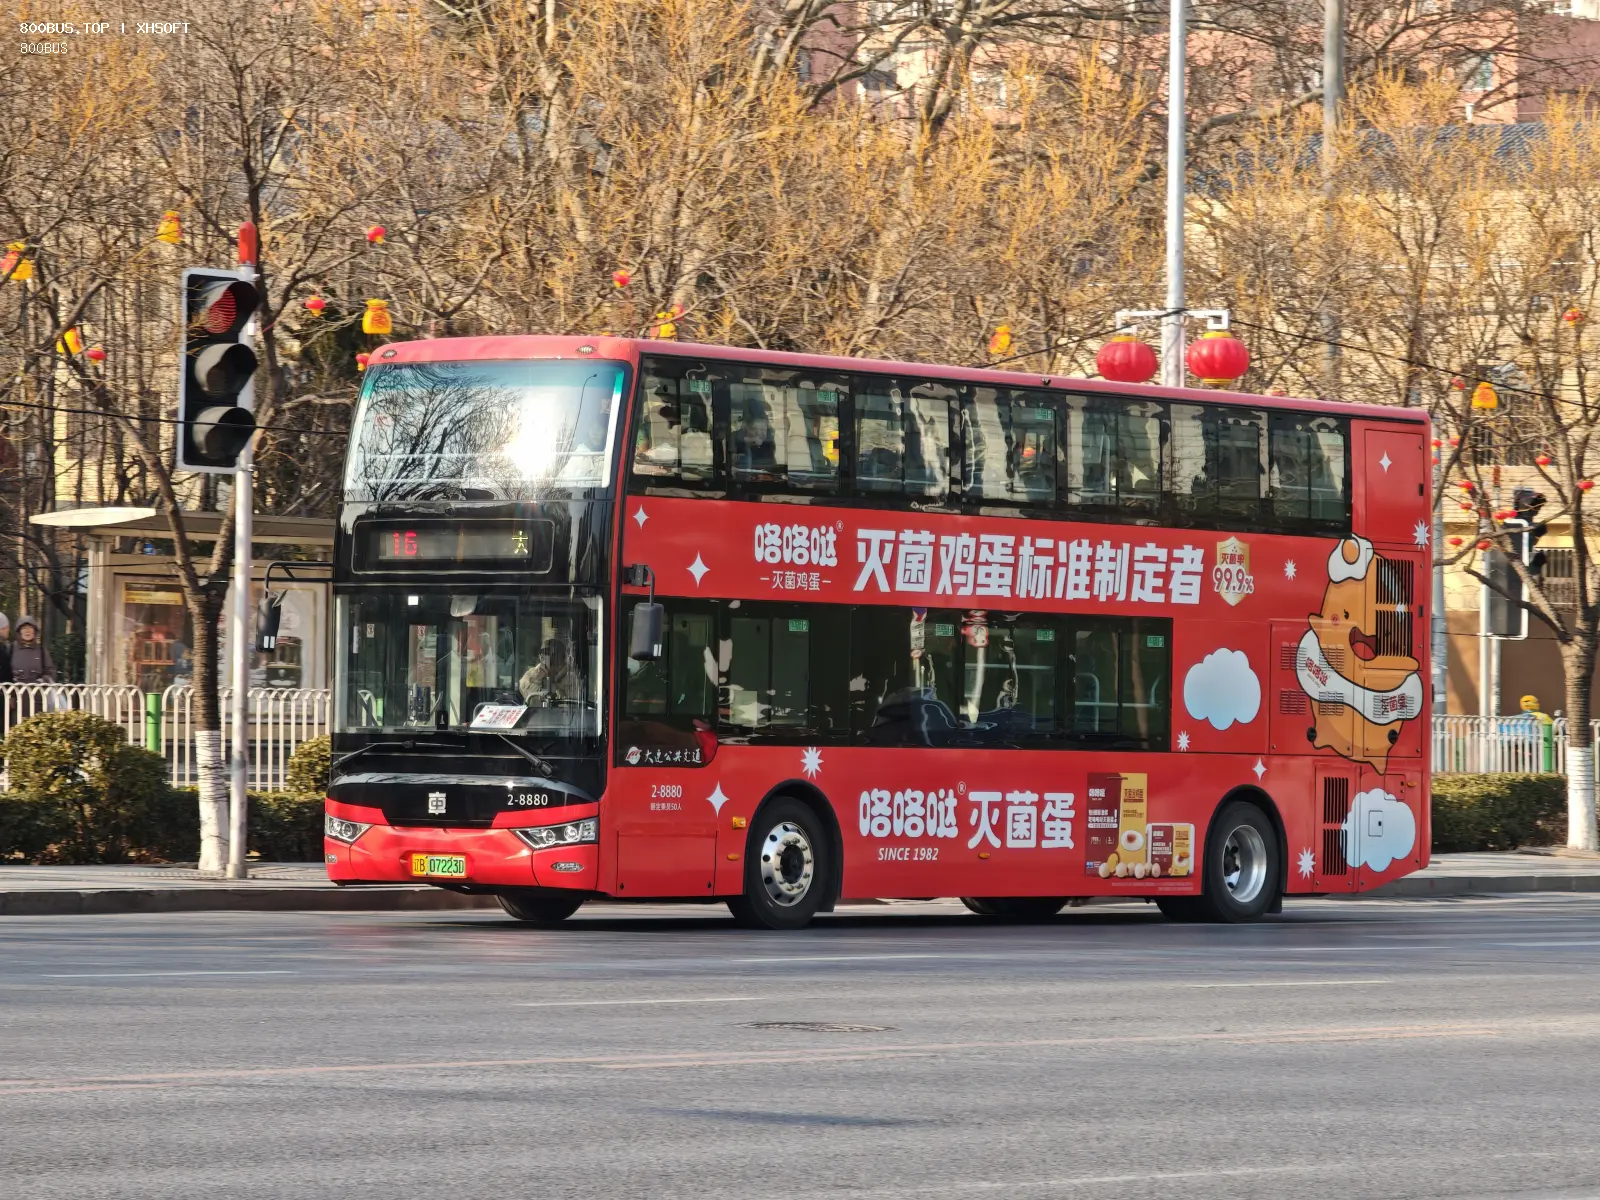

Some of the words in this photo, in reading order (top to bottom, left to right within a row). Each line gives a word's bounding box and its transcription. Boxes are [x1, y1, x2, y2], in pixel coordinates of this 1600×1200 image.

[393, 531, 417, 556] 16
[754, 522, 838, 567] 咯咯哒
[852, 528, 1205, 605] 灭菌鸡蛋标准制定者
[1221, 552, 1245, 566] 灭菌率
[1213, 566, 1254, 594] 99.9%
[507, 793, 548, 806] 2-8880
[651, 784, 682, 798] 2-8880
[859, 788, 958, 838] 咯咯哒
[967, 790, 1076, 850] 灭菌蛋
[877, 847, 911, 861] SINCE
[912, 847, 939, 861] 1982
